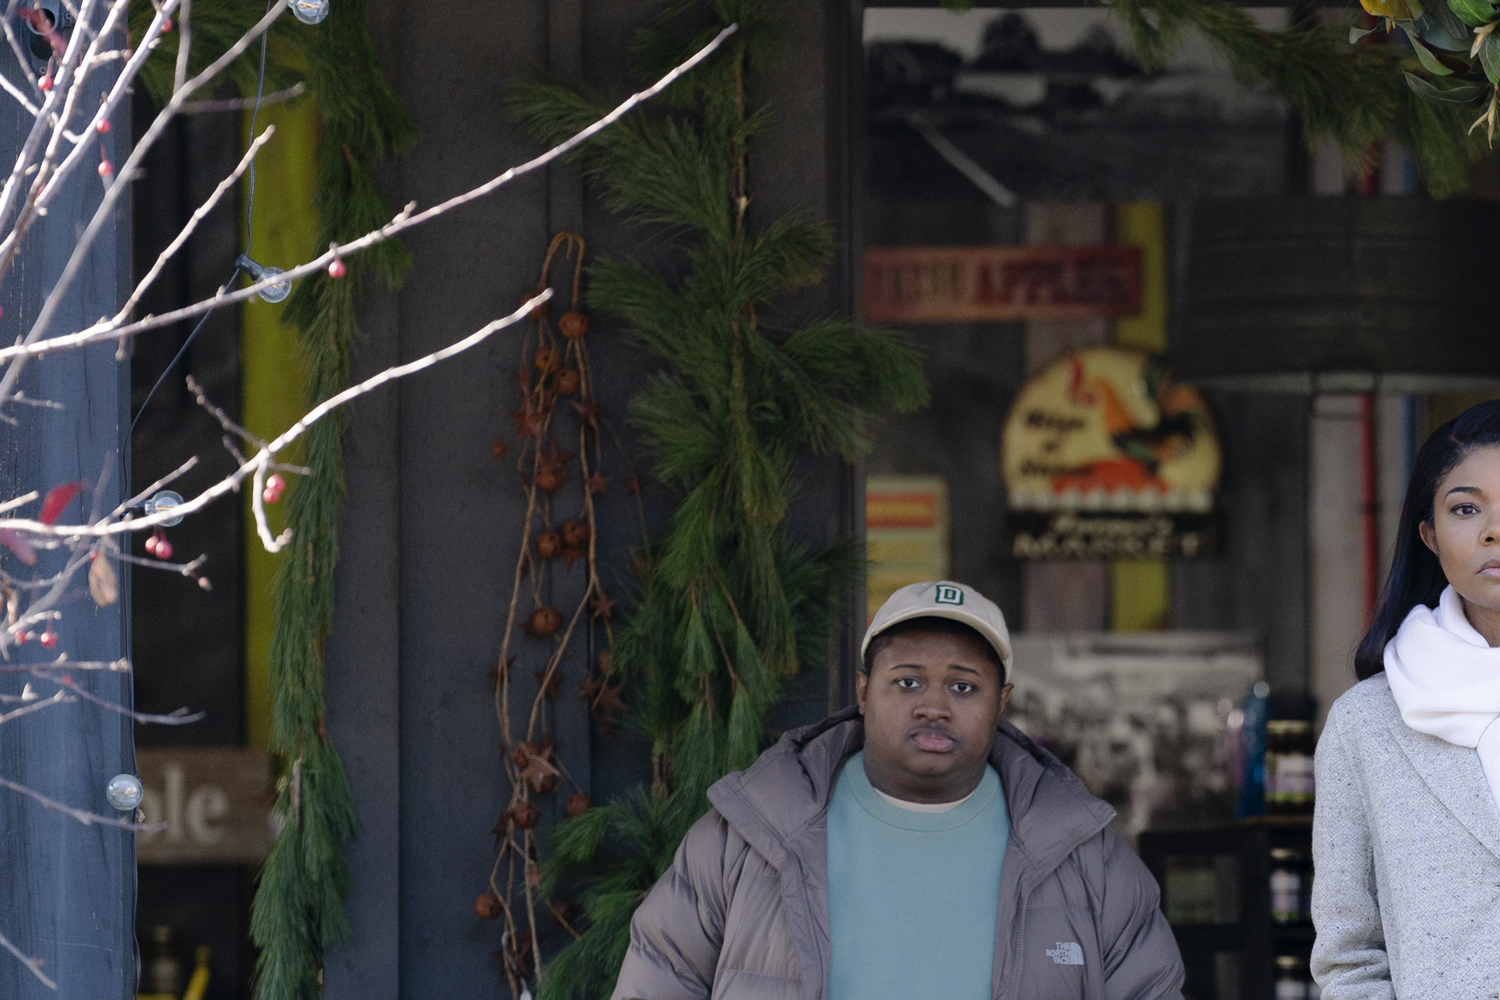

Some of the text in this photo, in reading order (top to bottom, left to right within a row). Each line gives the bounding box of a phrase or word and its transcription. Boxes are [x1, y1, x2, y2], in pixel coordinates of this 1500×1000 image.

[935, 584, 964, 606] D
[1055, 942, 1071, 950] THE
[1045, 949, 1071, 957] NORTH
[1053, 957, 1071, 965] FACE
